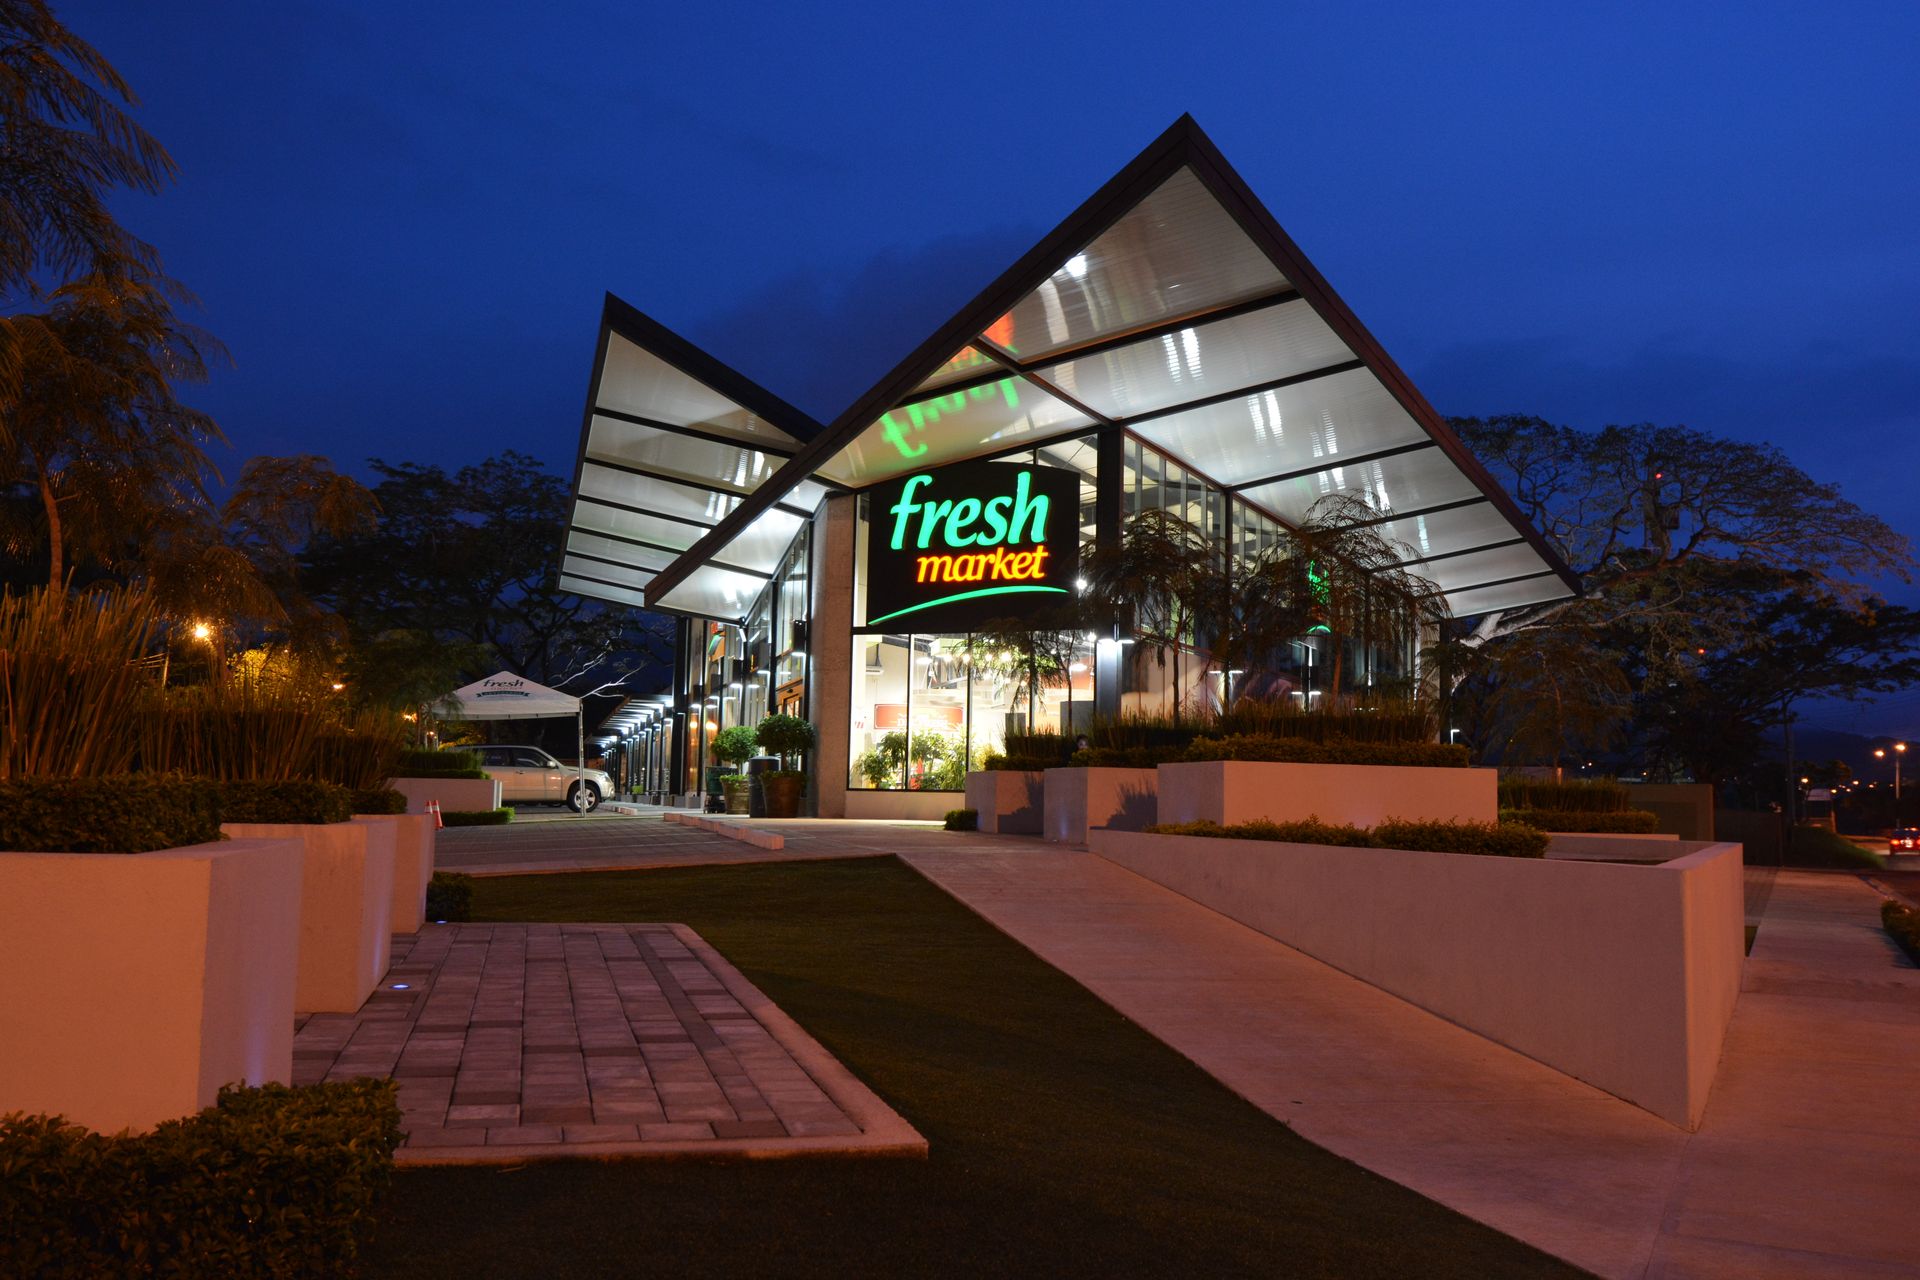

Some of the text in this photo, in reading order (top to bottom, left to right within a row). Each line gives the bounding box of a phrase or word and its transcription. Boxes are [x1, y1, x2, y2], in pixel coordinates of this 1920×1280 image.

[890, 472, 1049, 549] fresh
[916, 545, 1049, 583] market
[483, 679, 524, 687] fresh
